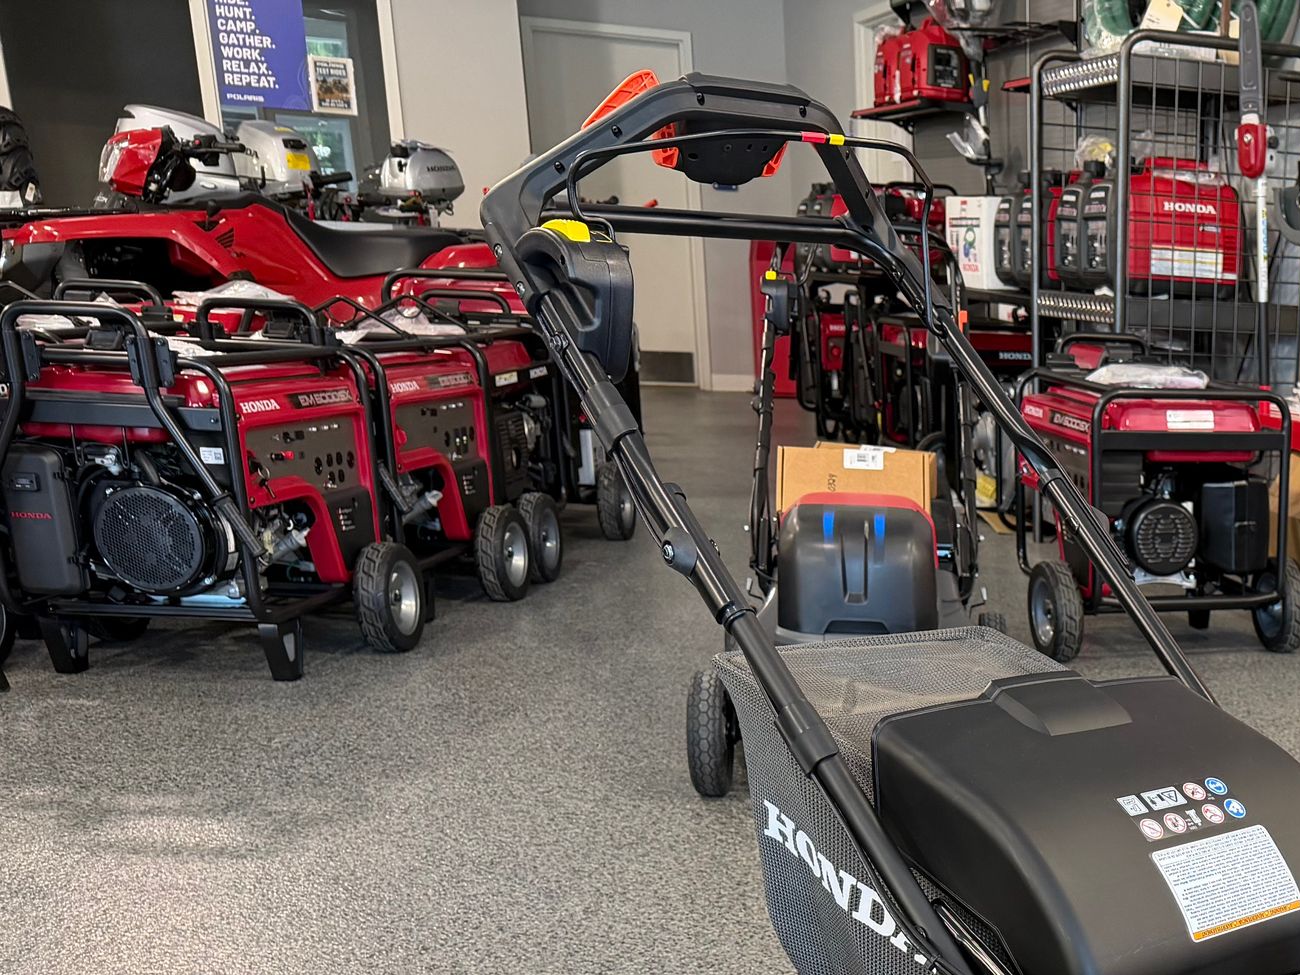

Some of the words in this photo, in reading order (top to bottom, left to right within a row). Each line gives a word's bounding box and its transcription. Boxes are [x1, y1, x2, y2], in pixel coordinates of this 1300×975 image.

[215, 6, 255, 19] HUNT.
[217, 19, 259, 33] CAMP.
[219, 33, 275, 48] GATHER.
[221, 46, 264, 61] WORK.
[222, 59, 272, 75] RELAX.
[224, 73, 279, 89] REPEAT.
[227, 93, 264, 102] POLARIS
[1164, 201, 1217, 215] HONDA
[391, 380, 421, 394] HONDA
[239, 399, 280, 413] HONDA
[10, 511, 53, 520] HONDA
